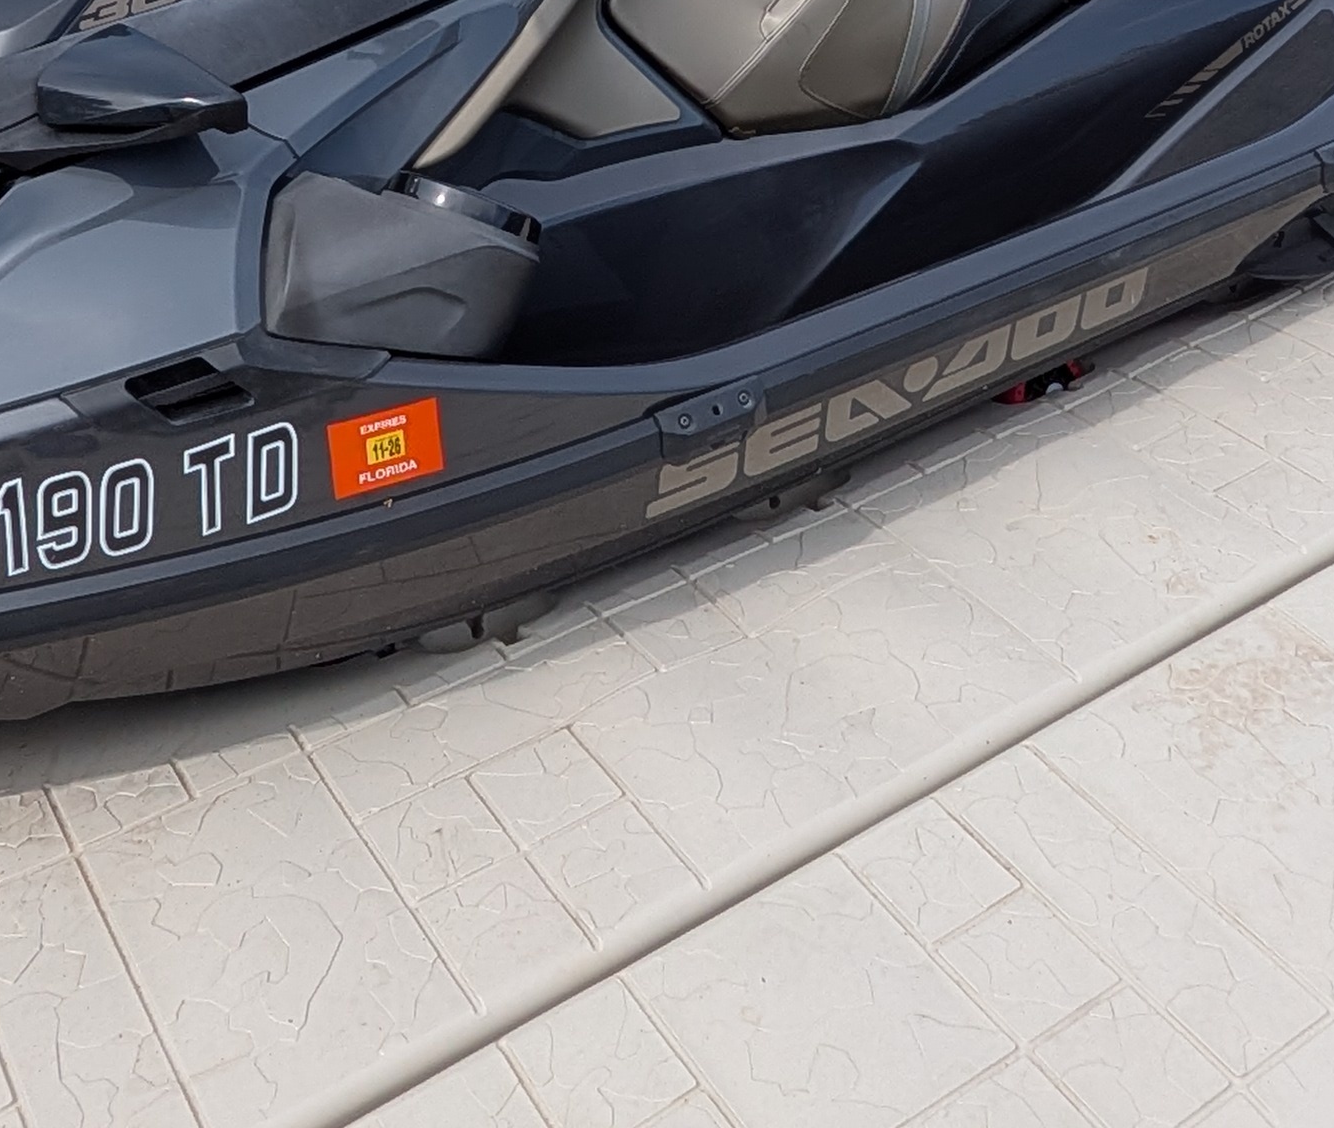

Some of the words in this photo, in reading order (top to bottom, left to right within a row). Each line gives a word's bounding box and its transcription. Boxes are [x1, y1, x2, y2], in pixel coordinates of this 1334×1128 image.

[1243, 1, 1291, 48] ROTAX
[359, 414, 407, 435] EXPIRES
[372, 436, 402, 461] 11-26
[183, 421, 299, 537] TD
[358, 458, 418, 485] FLORIDA
